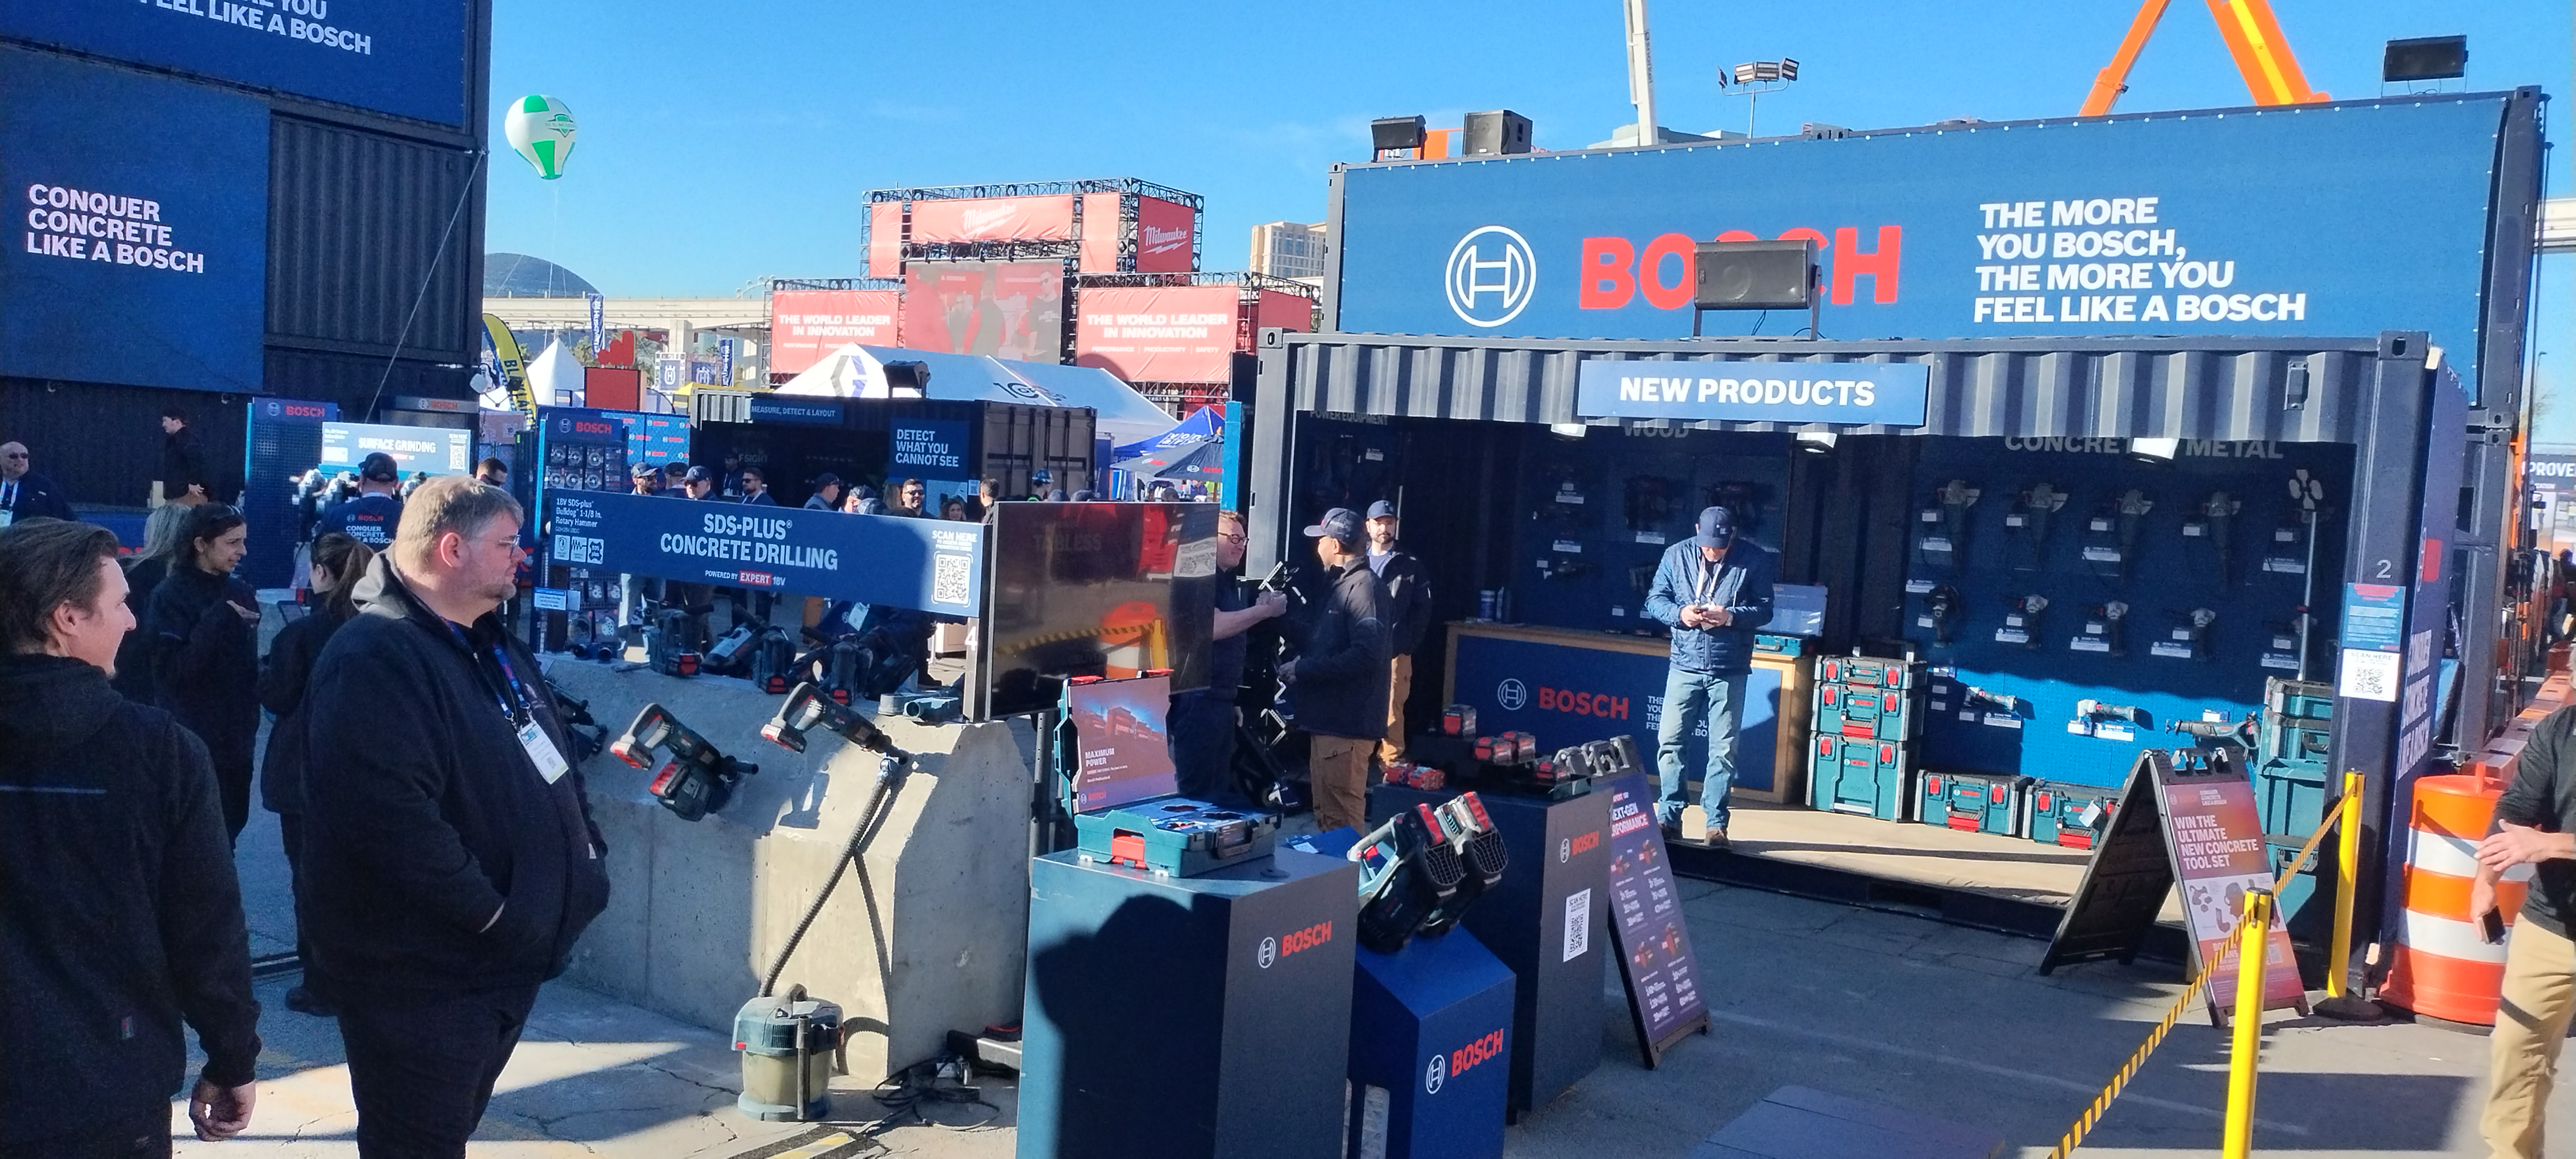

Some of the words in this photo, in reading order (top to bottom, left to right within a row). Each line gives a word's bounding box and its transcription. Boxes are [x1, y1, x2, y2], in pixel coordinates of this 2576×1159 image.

[209, 0, 263, 30] LIKE
[267, 14, 287, 35] A
[290, 18, 371, 55] BOSCH
[29, 184, 160, 222] CONQUER
[961, 203, 1017, 230] Milwaukee
[1980, 202, 2045, 229] THE
[2051, 197, 2158, 227] MORE
[29, 208, 173, 246] CONCRETE
[1144, 225, 1188, 246] Milwaukee
[27, 232, 86, 259] LIKE
[92, 241, 112, 262] A
[117, 244, 204, 273] BOSCH
[1977, 233, 2046, 260] YOU
[2054, 229, 2186, 263] BOSCH,
[1579, 224, 1902, 311] BOH
[1975, 265, 2041, 291] THE
[2047, 262, 2152, 290] MORE
[2158, 260, 2234, 289] YOU
[1974, 297, 2055, 322] FEEL
[2061, 297, 2137, 322] LIKE
[2143, 297, 2171, 321] A
[2177, 293, 2306, 321] BOSCH
[779, 315, 800, 324] THE
[803, 315, 843, 325] WORLD
[846, 316, 891, 325] LEADER
[1086, 315, 1113, 325] THE
[1117, 315, 1167, 325] WORLD
[1170, 314, 1228, 325] LEADER
[793, 326, 804, 335] IN
[807, 326, 875, 336] INNOVATION
[1103, 327, 1118, 338] IN
[1122, 327, 1208, 338] INNOVATION
[1620, 377, 1692, 403] NEW
[1698, 380, 1875, 406] PRODUCTS
[286, 405, 325, 417] BOSCH
[751, 406, 781, 415] MEASURE,
[783, 408, 805, 416] DETECT
[1310, 410, 1341, 421] POWER
[1342, 412, 1388, 426] EQUIPMENT
[576, 421, 611, 434] BOSCH
[897, 429, 935, 441] DETECT
[358, 437, 394, 450] SURFACE
[395, 439, 436, 453] GRINDING
[896, 441, 927, 453] WHAT
[928, 443, 949, 455] YOU
[2005, 437, 2133, 454] CONCRET
[2185, 438, 2284, 459] METAL
[896, 454, 937, 465] CANNOT
[940, 456, 959, 467] SEE
[557, 498, 567, 506] 18V
[556, 516, 573, 526] Rotary
[574, 519, 597, 527] Hammer
[932, 530, 954, 541] SCAN
[955, 532, 977, 543] HERE
[661, 533, 751, 561] CONCRETE
[755, 542, 838, 570] DRILLING
[2377, 560, 2391, 578] 2
[705, 570, 730, 579] POWERED
[740, 573, 770, 585] EXPERT
[773, 576, 785, 586] 18V
[964, 627, 977, 650] 4
[1539, 687, 1629, 720] BOSCH
[1647, 704, 1662, 712] YOU
[1648, 696, 1664, 704] THE
[1085, 748, 1114, 759] MAXIMUM
[1086, 757, 1106, 767] POWER
[1612, 814, 1648, 836] RFORMANCE
[2174, 817, 2197, 829] WIN
[2197, 815, 2217, 827] THE
[1572, 831, 1599, 855] BOSCH
[2178, 828, 2227, 843] ULTIMATE
[2181, 842, 2204, 856] NEW
[2205, 839, 2259, 853] CONCRETE
[2183, 857, 2212, 870] TOOL
[2212, 855, 2230, 868] SET
[1282, 921, 1331, 956] BOSCH
[1452, 1028, 1503, 1077] BOSCH
